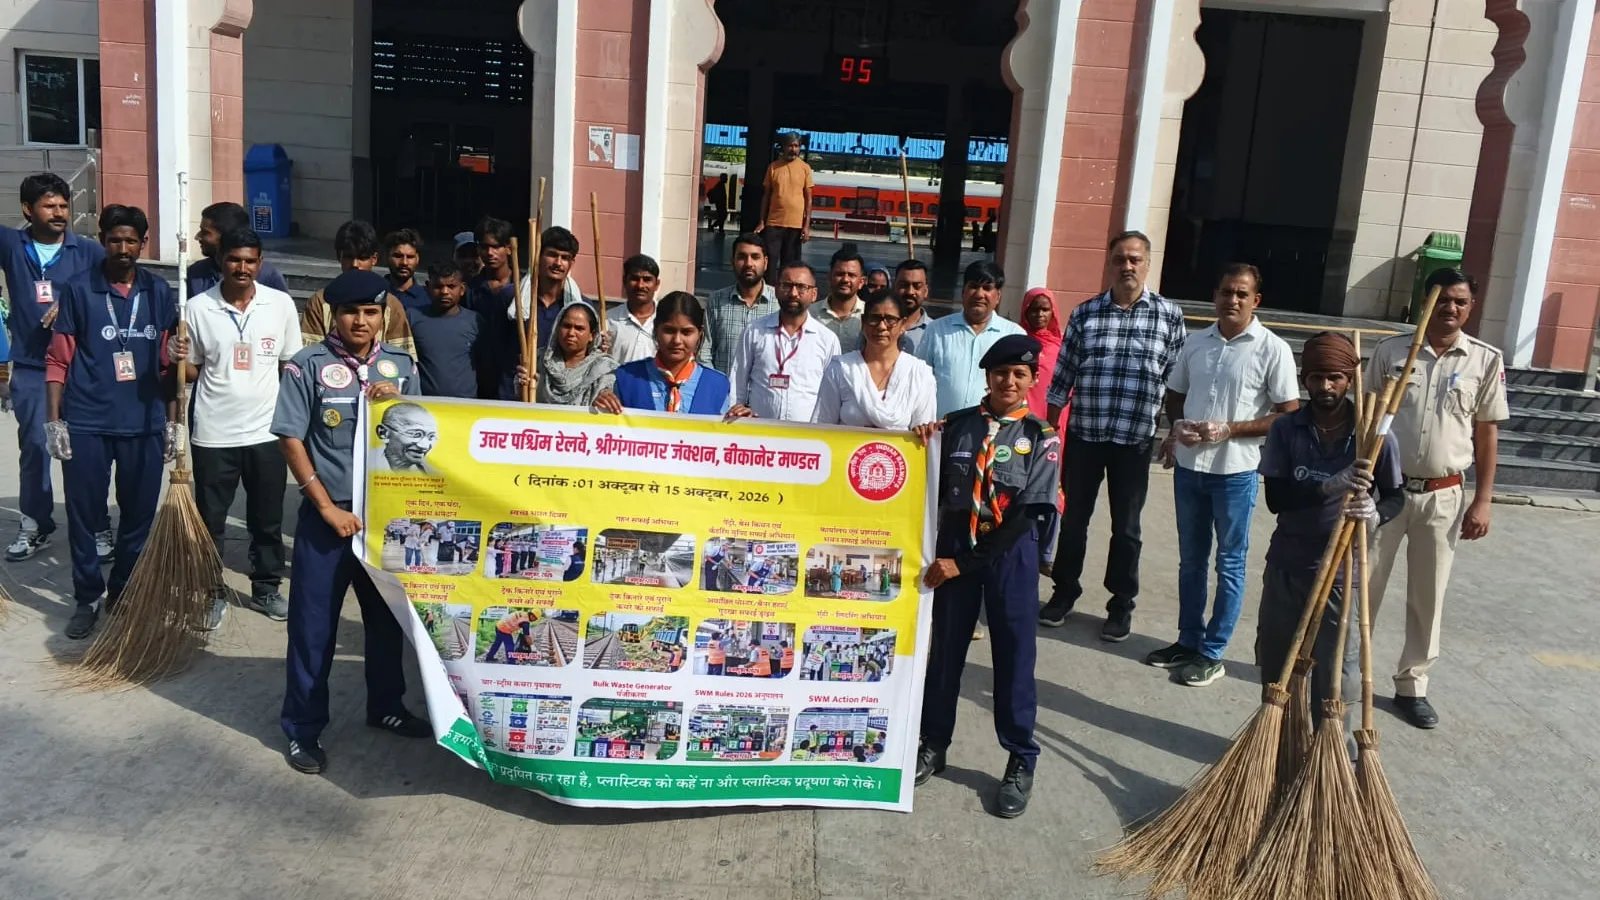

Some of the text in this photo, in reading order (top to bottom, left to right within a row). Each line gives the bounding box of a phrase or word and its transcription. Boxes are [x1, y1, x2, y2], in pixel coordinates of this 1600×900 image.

[840, 57, 872, 83] 95
[479, 428, 821, 470] उत्तर पश्चिम रेलवे, श्रीगंगानगर जंक्शन, बीकानेर मण्डल
[875, 443, 898, 457] INDIAN
[528, 473, 569, 488] दिनांक
[598, 479, 644, 495] अक्टूबर
[648, 481, 660, 494] से
[665, 485, 680, 496] 15
[683, 486, 733, 502] अक्टूबर,
[738, 491, 770, 503] 2026
[406, 499, 417, 507] एक
[406, 509, 417, 517] एक
[611, 681, 634, 689] Waste
[635, 682, 672, 691] Generator
[694, 689, 714, 697] SWM
[808, 694, 879, 704] SWM Action Plan
[500, 764, 533, 781] प्रदूषित
[535, 772, 553, 785] कर
[556, 774, 576, 787] रहा
[579, 770, 592, 788] है,
[596, 773, 652, 788] प्लास्टिक
[655, 774, 674, 788] को
[676, 774, 698, 790] कहें
[700, 778, 714, 788] ना
[716, 774, 739, 788] और
[742, 775, 792, 788] प्लास्टिक
[794, 777, 830, 790] प्रदूषण
[832, 774, 850, 788] को
